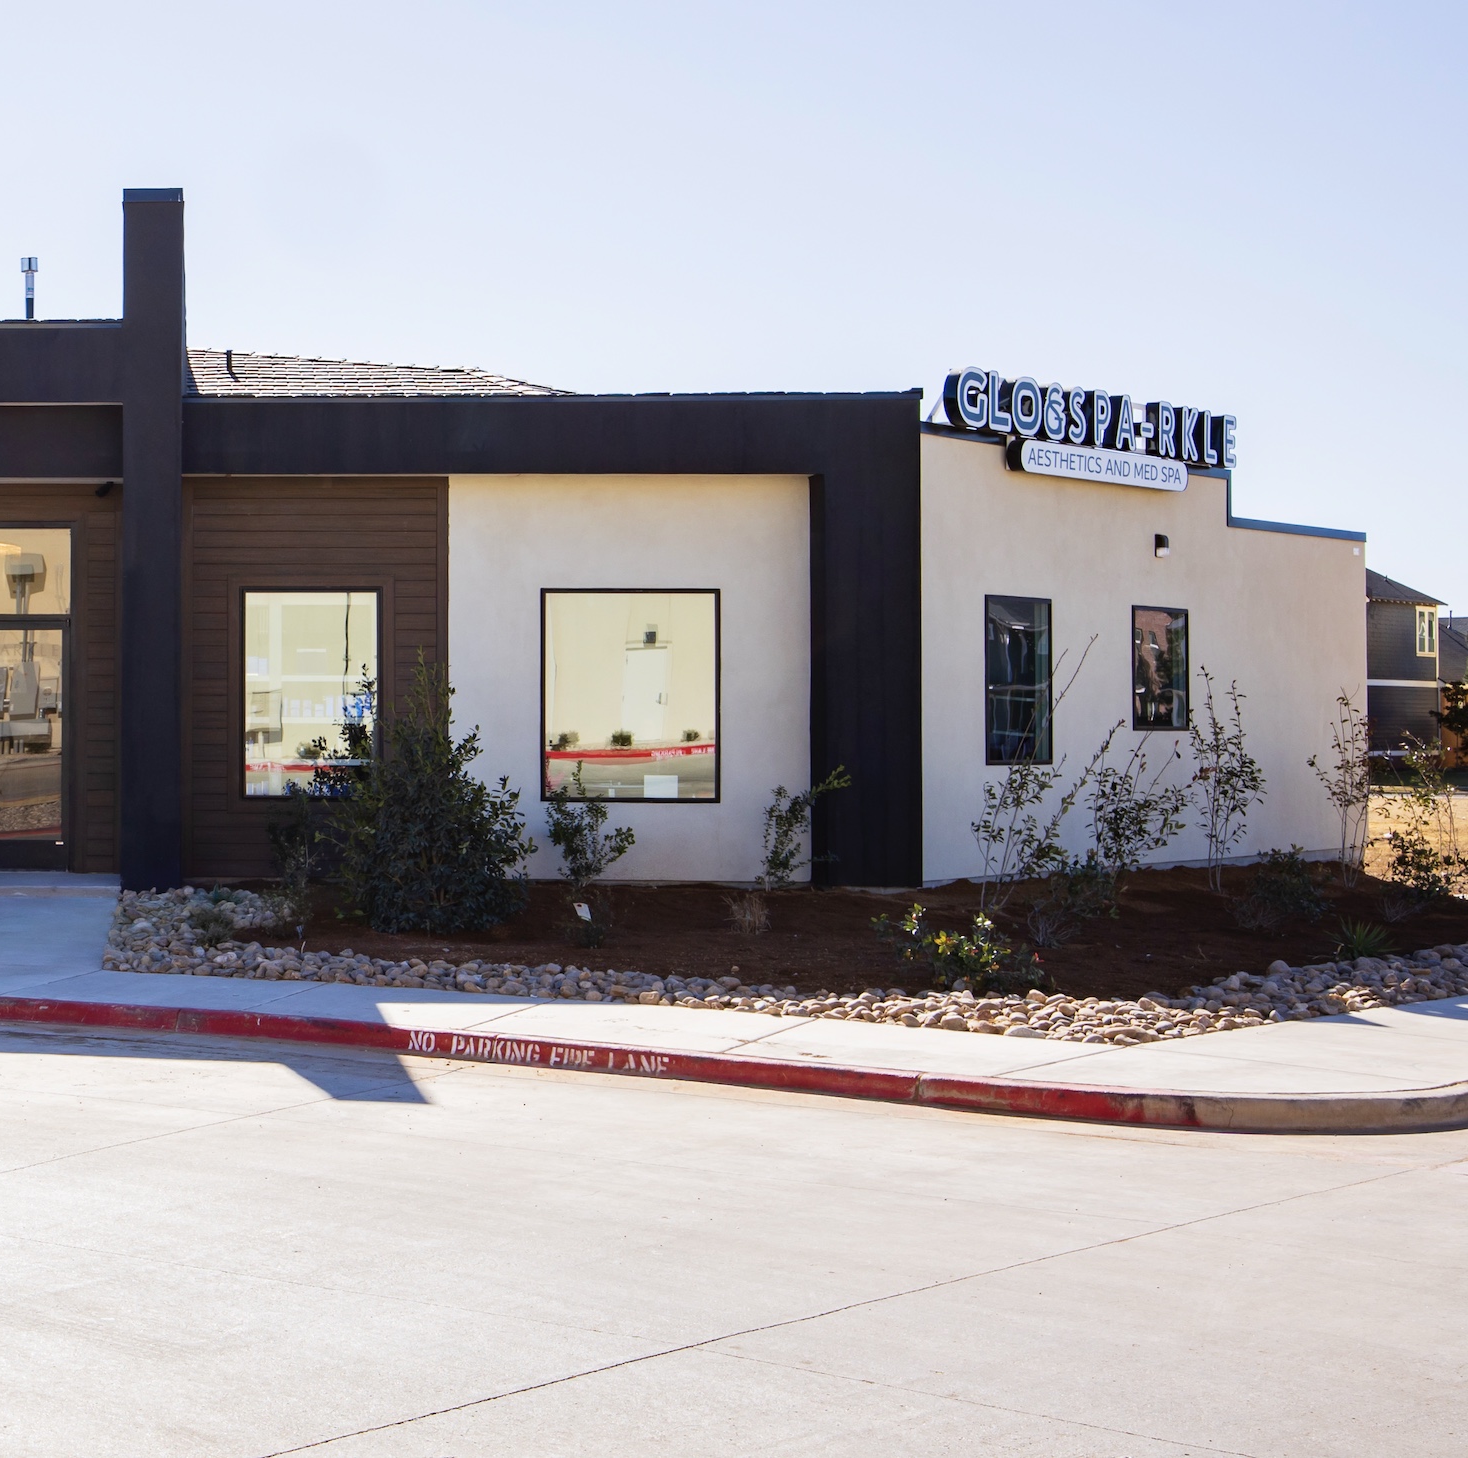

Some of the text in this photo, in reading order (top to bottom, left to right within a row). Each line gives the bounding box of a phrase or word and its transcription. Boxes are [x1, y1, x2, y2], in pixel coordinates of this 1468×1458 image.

[1027, 447, 1182, 485] AESTHETICS AND MED SPA
[408, 1030, 436, 1052] NO
[450, 1035, 541, 1063] PARKING
